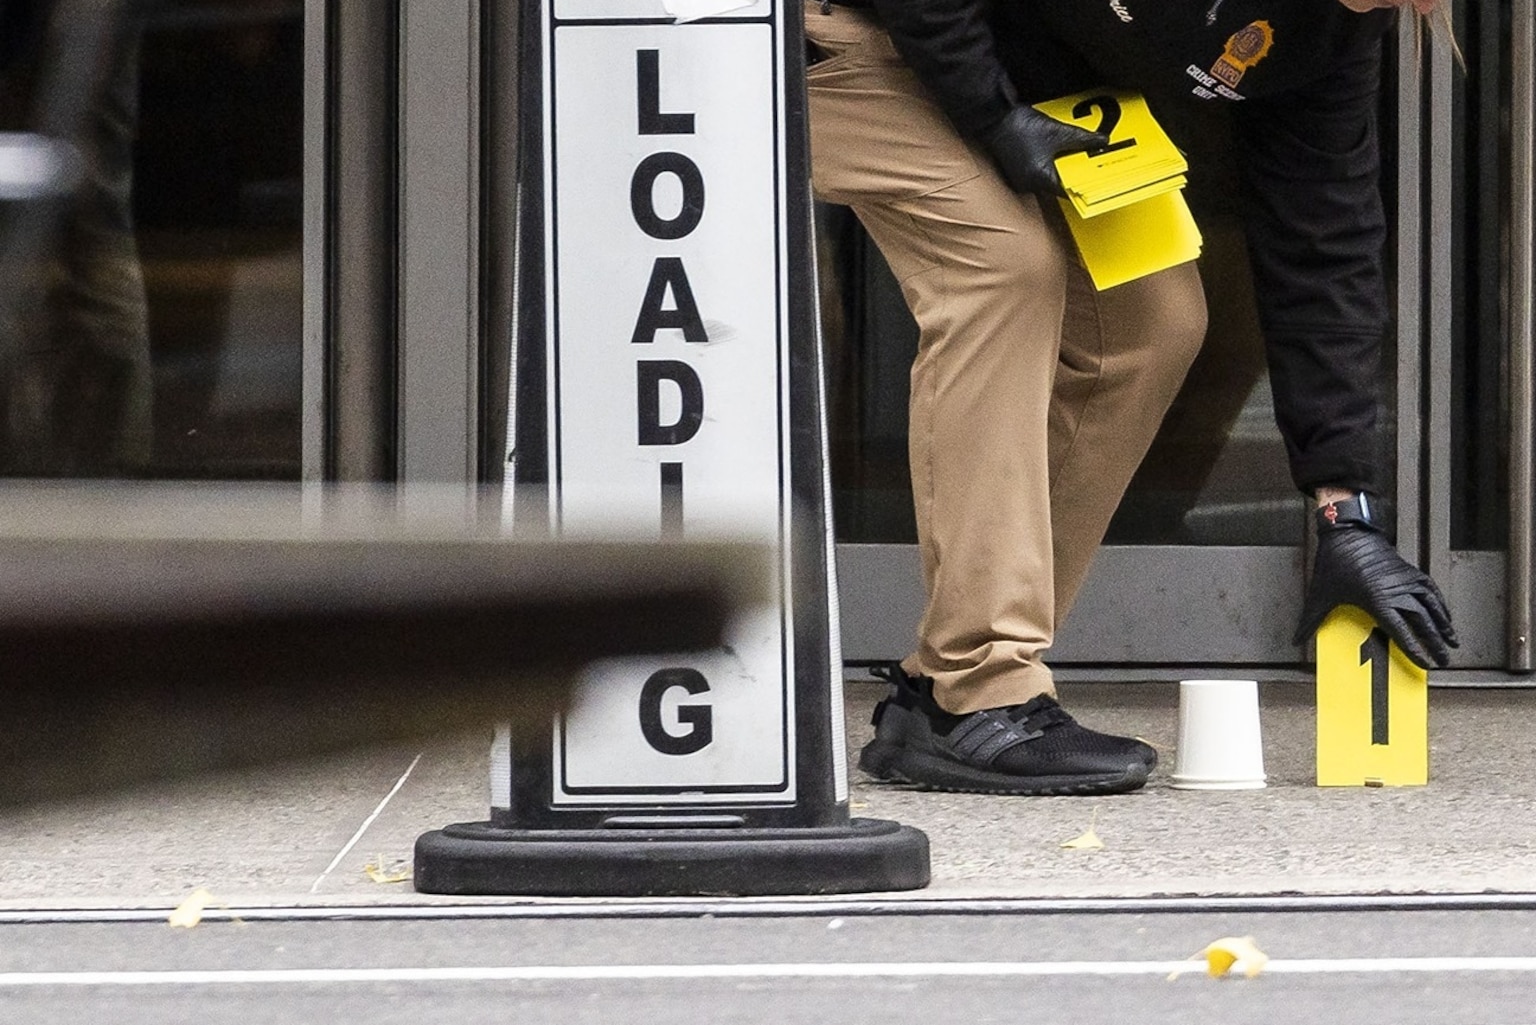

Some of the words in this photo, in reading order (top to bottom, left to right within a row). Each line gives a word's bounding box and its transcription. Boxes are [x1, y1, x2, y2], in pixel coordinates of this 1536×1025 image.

[1186, 64, 1218, 87] CRIME
[1191, 85, 1219, 100] UNIT
[1213, 60, 1240, 82] NYPD
[1072, 95, 1138, 158] 2
[629, 48, 715, 757] LOADIG
[1360, 627, 1390, 746] 1
